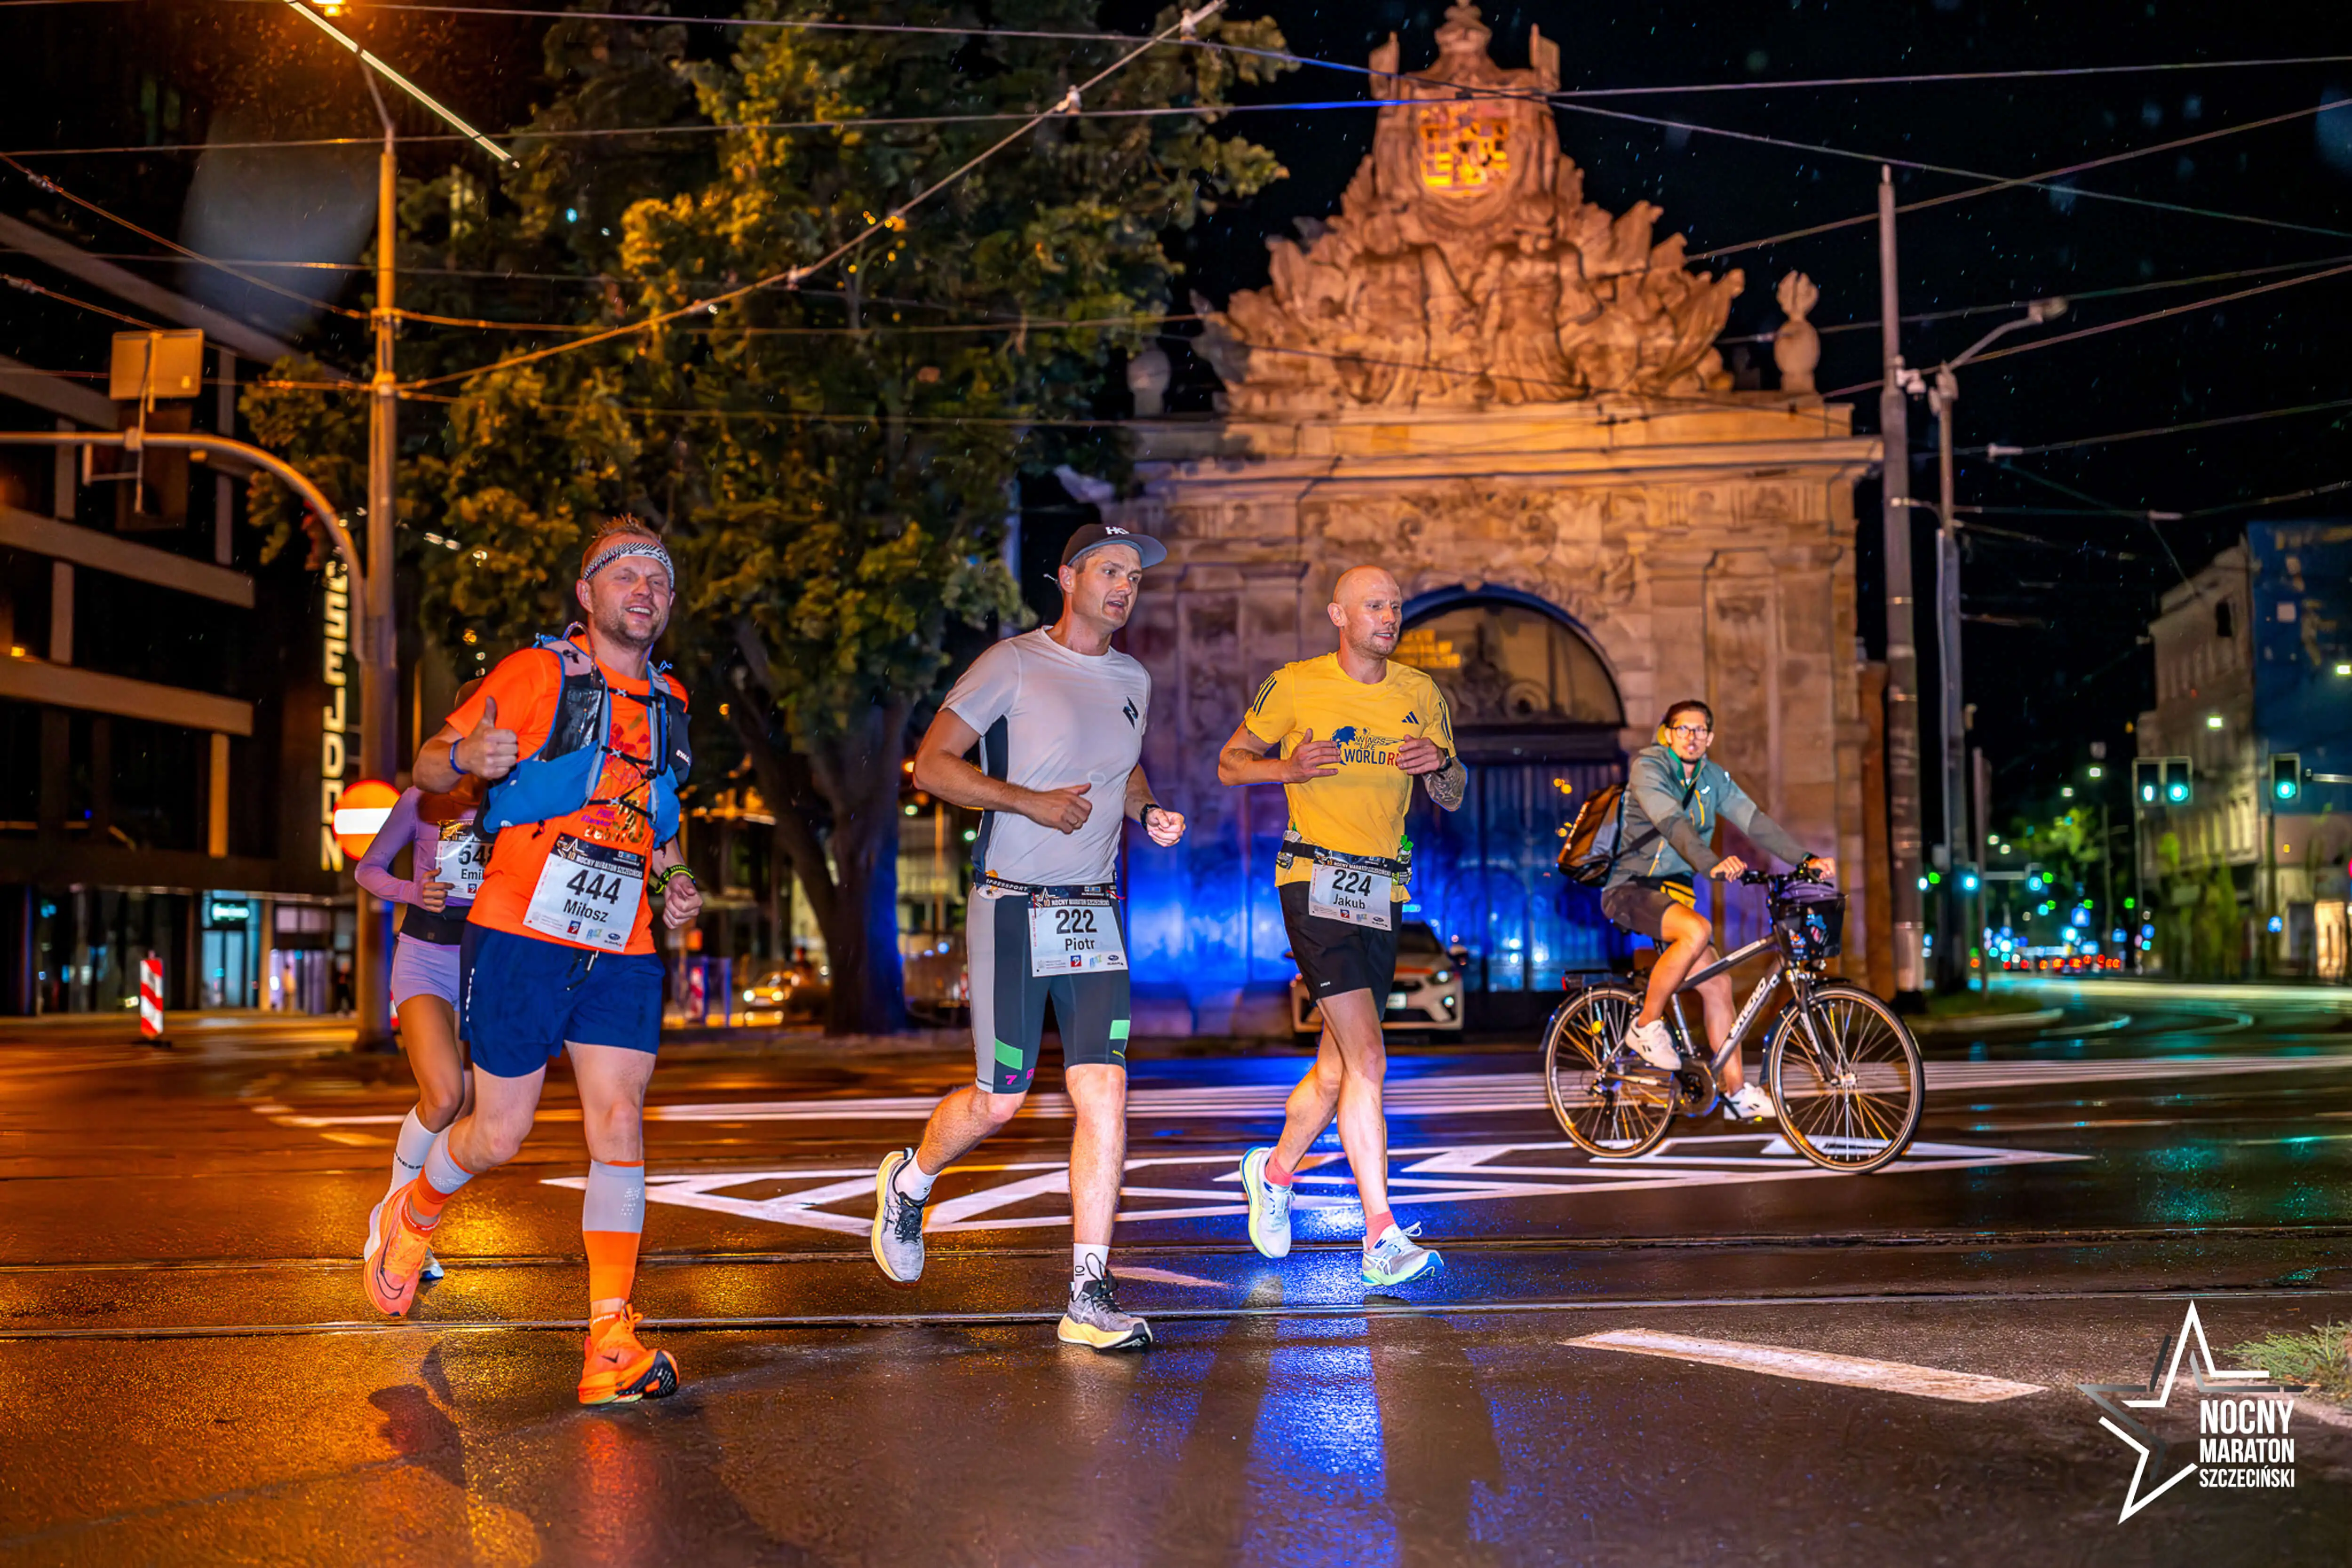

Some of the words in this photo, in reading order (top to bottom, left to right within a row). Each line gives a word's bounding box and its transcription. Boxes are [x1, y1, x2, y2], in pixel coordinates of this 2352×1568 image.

[566, 869, 622, 905] 444
[1332, 869, 1372, 897] 224
[563, 899, 609, 923] Miłosz
[1333, 894, 1366, 909] Jakub
[1055, 908, 1097, 935] 222
[1065, 937, 1095, 952] Piotr
